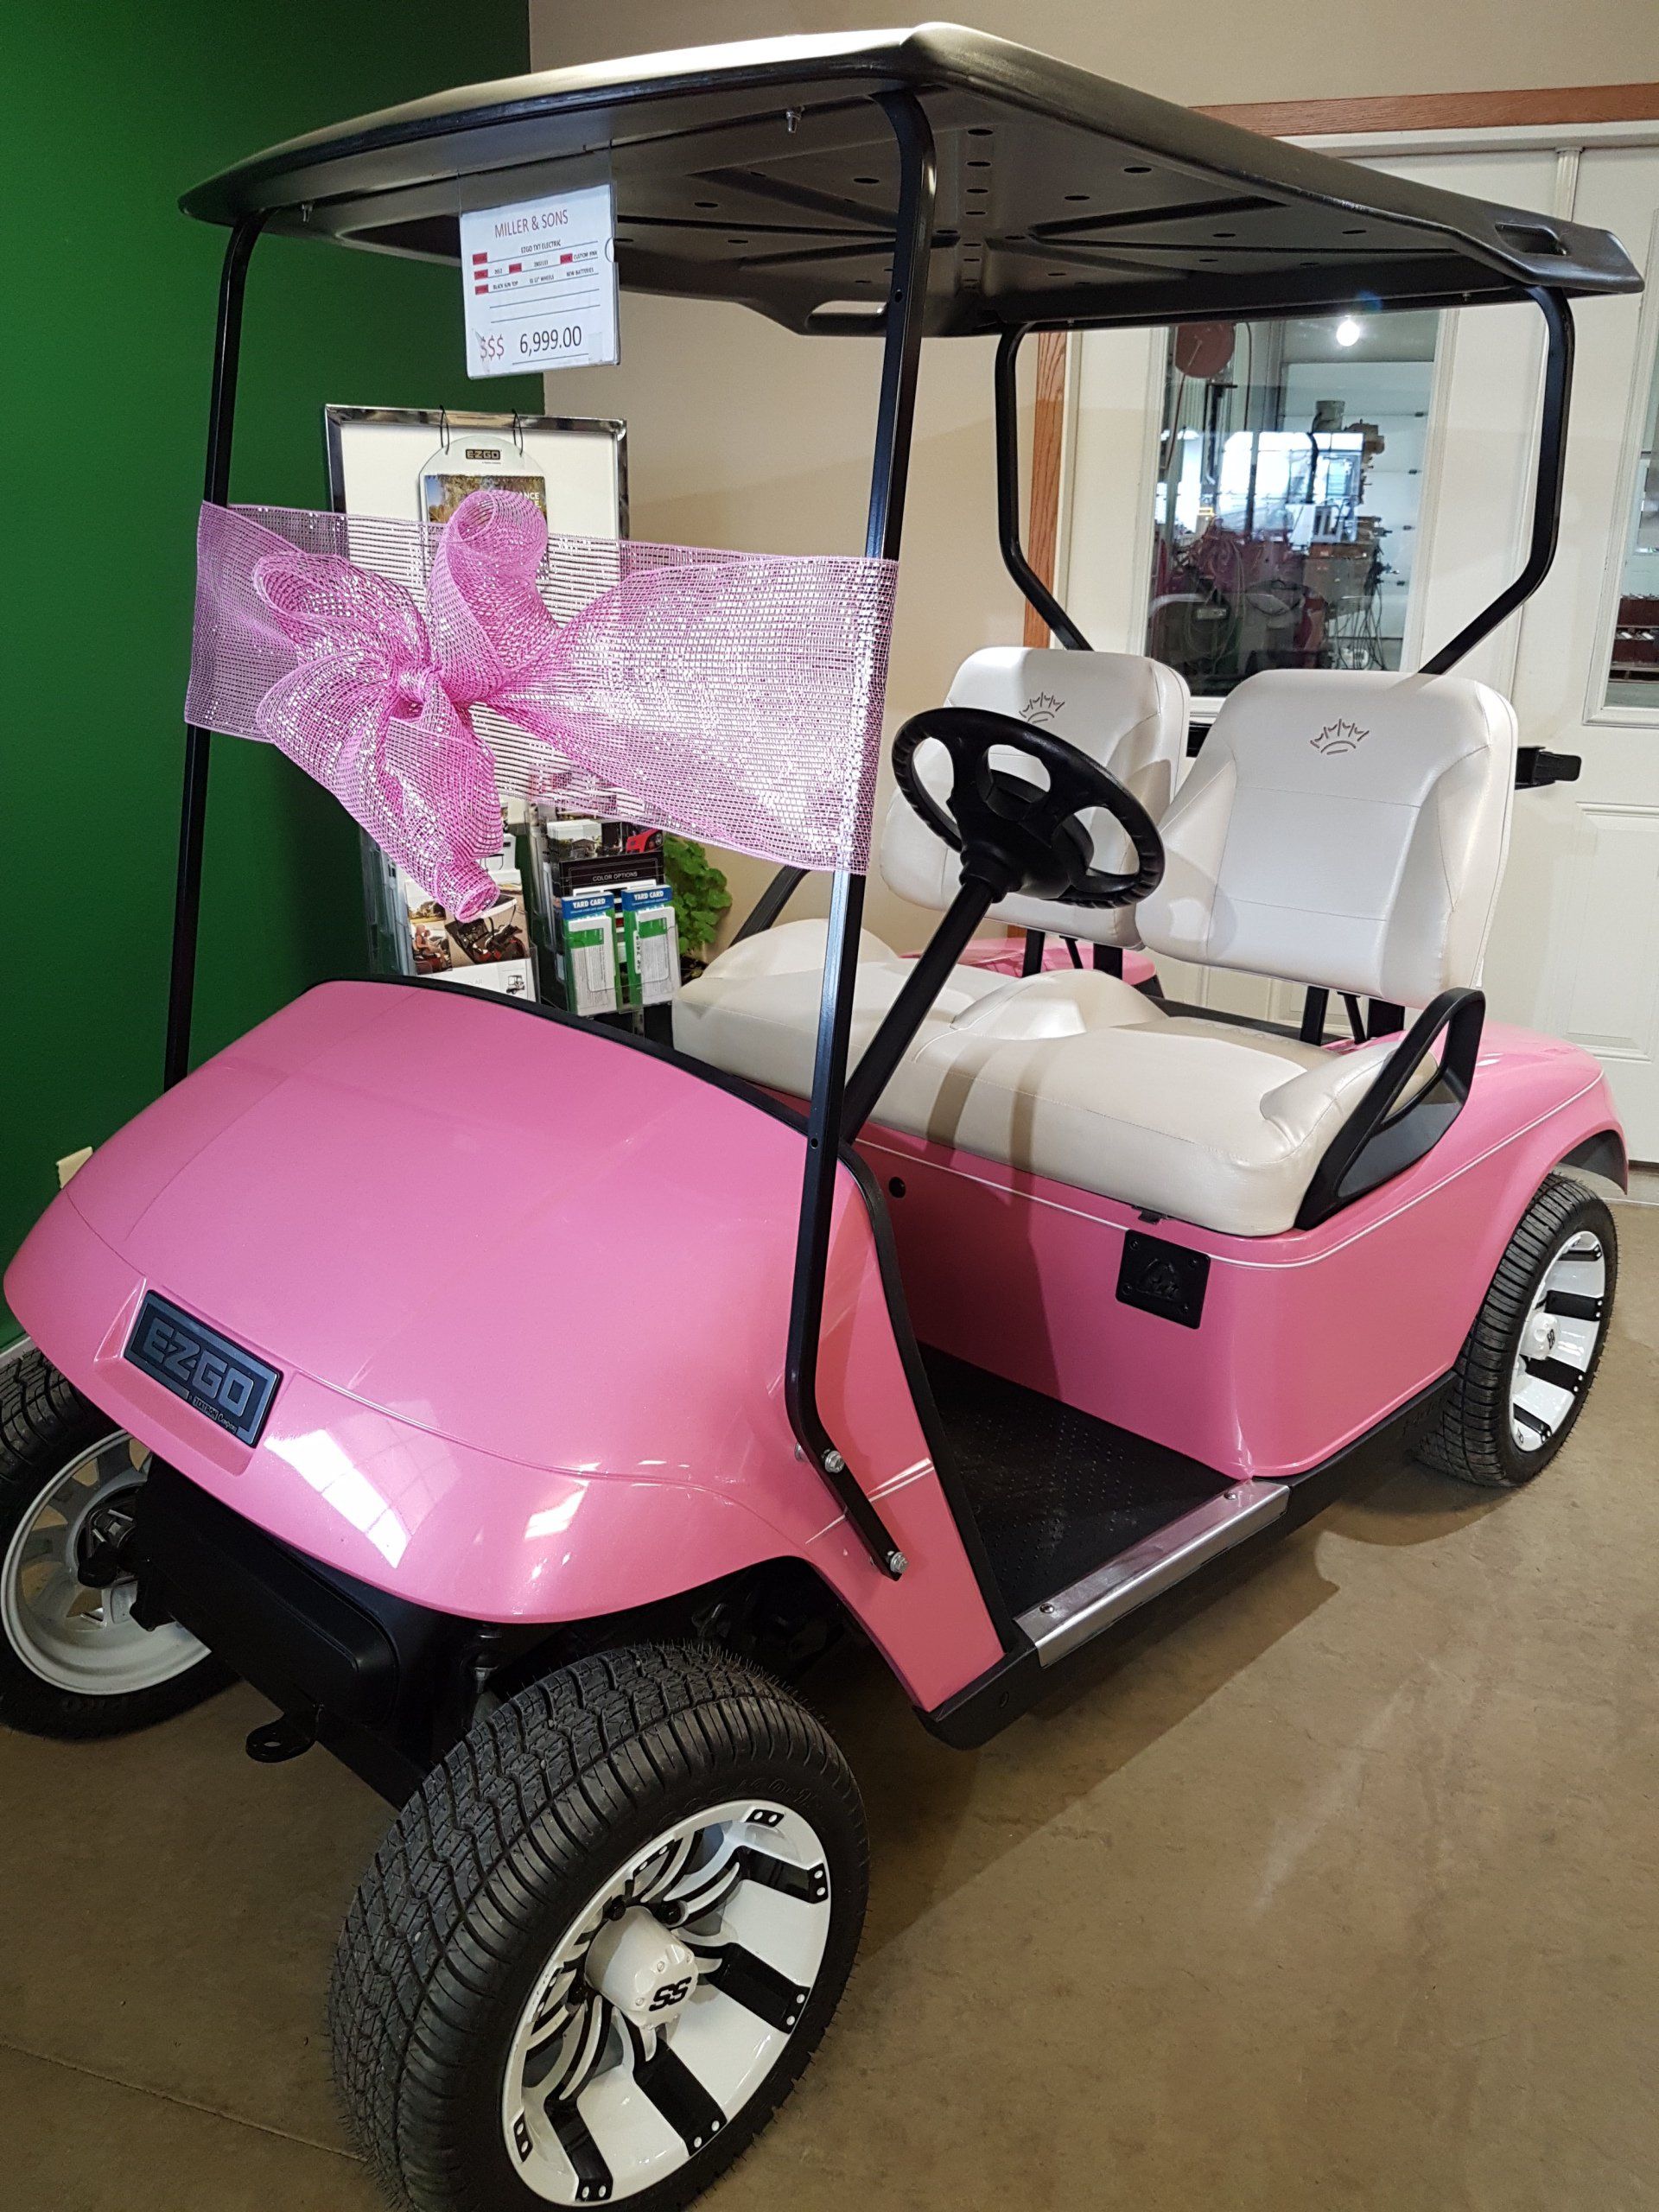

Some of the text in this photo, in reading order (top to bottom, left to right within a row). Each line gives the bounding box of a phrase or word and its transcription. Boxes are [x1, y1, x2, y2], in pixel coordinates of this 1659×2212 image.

[494, 209, 569, 238] MILLER & SONS
[520, 326, 582, 357] 6,999.00
[592, 871, 638, 882] COLOR OPTIONS
[589, 898, 606, 906] CARD
[648, 1975, 692, 2012] SS
